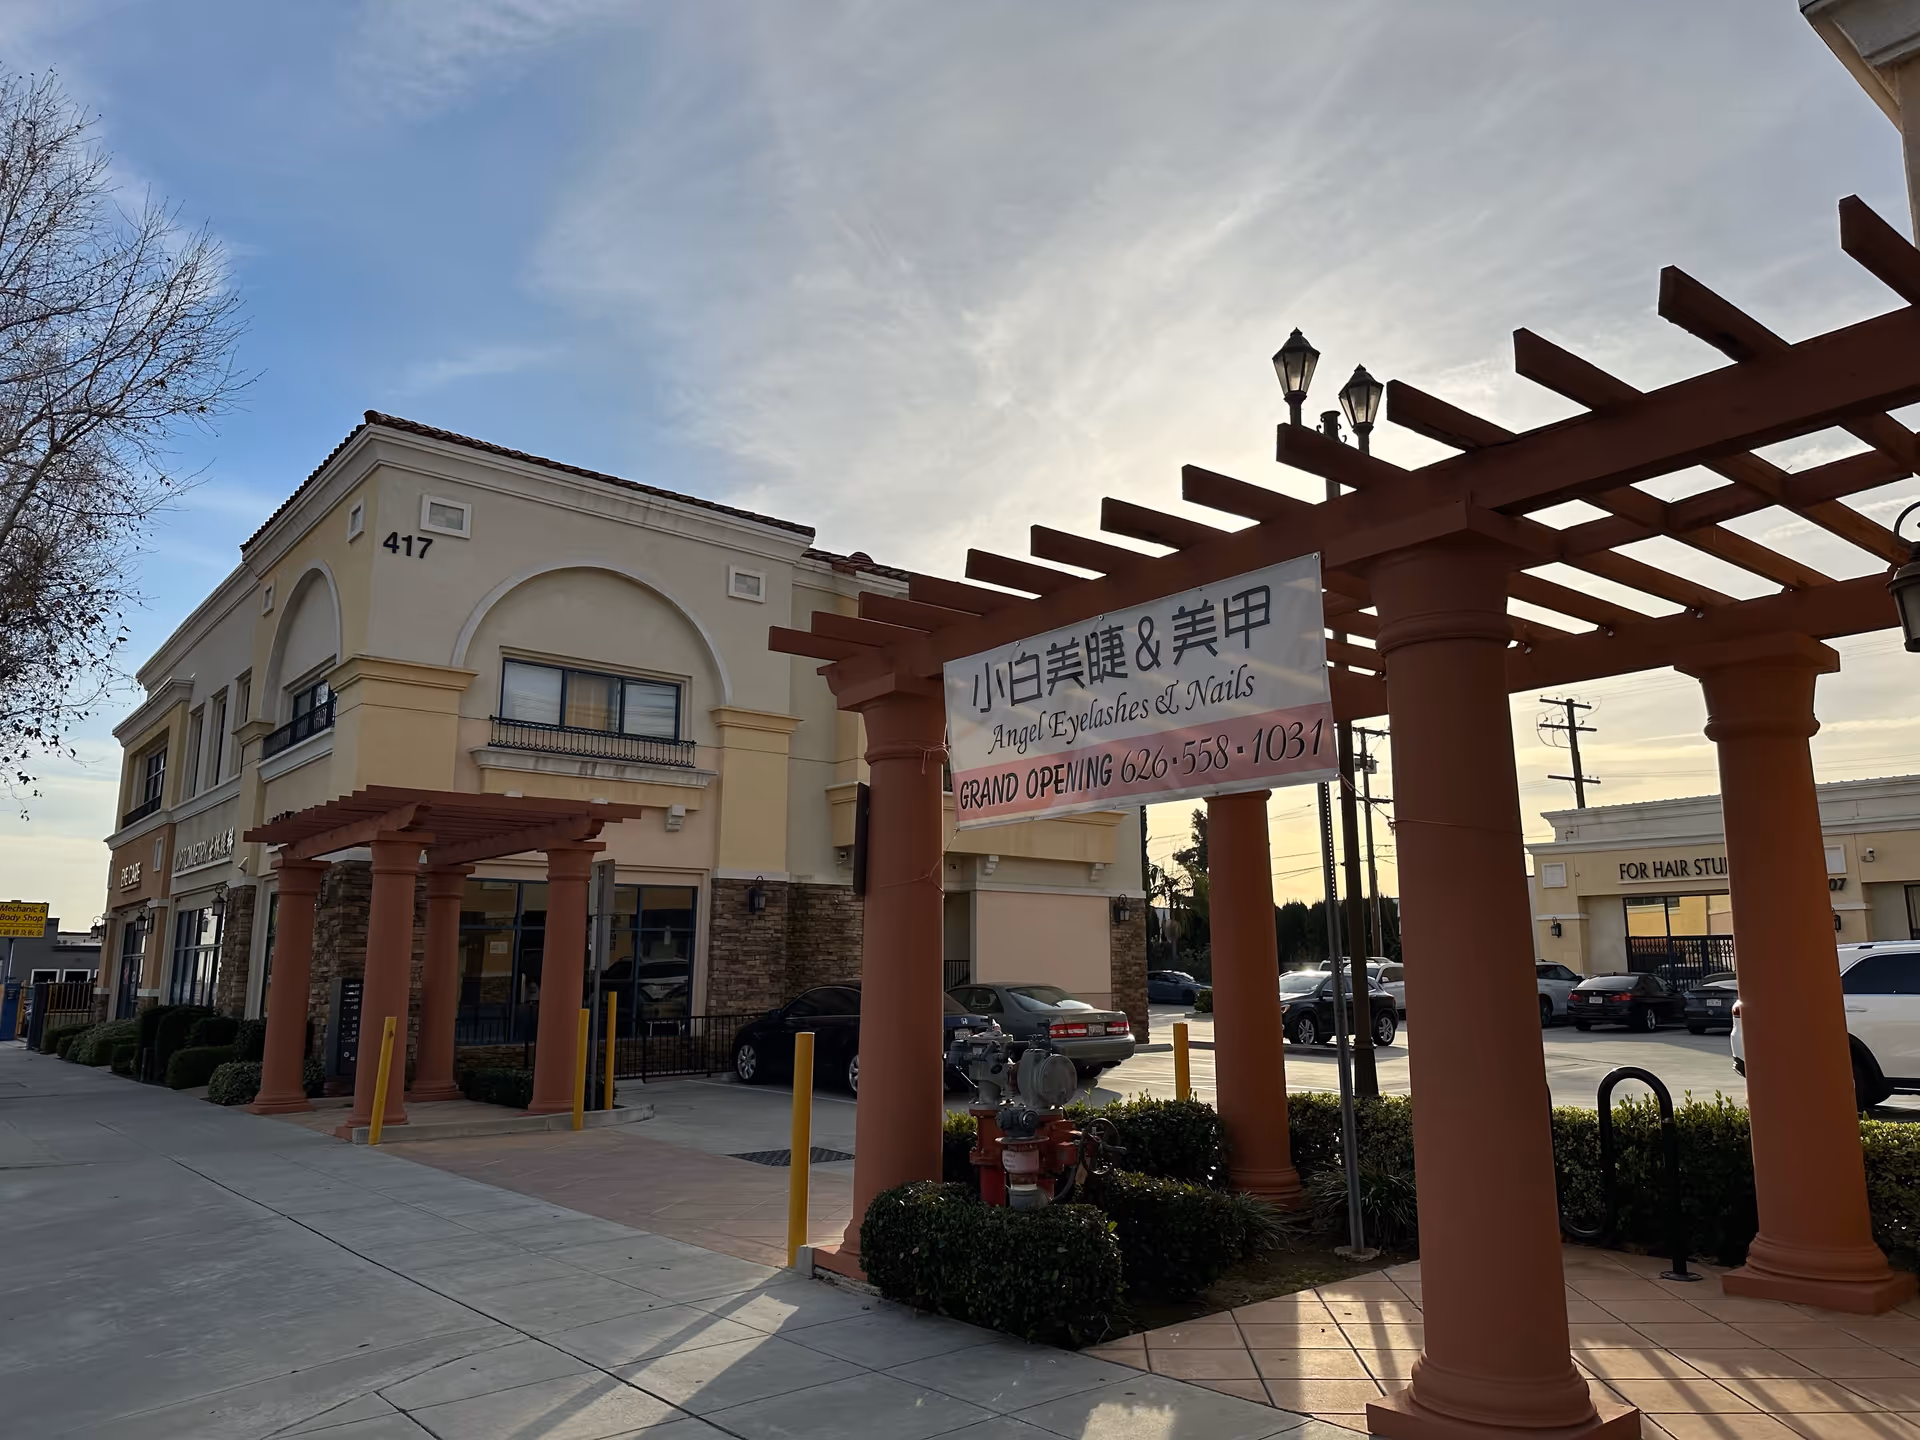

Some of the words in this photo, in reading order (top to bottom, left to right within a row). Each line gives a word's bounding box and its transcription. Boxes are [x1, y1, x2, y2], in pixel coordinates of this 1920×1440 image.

[383, 531, 433, 559] 417
[972, 624, 1128, 713] 小白美睫
[1136, 616, 1161, 672] &
[1172, 585, 1271, 666] 美甲
[988, 711, 1053, 754] Angel
[1049, 692, 1148, 744] Eyelashes
[1155, 679, 1179, 715] &
[1185, 664, 1255, 711] Nails
[960, 773, 1019, 811] GRAND
[1026, 753, 1112, 800] OPENING
[1619, 862, 1649, 879] FOR
[1652, 859, 1690, 878] HAIR
[1694, 857, 1728, 876] STU
[0, 904, 38, 913] Mechanic
[0, 913, 21, 922] Body
[23, 913, 43, 923] Shop
